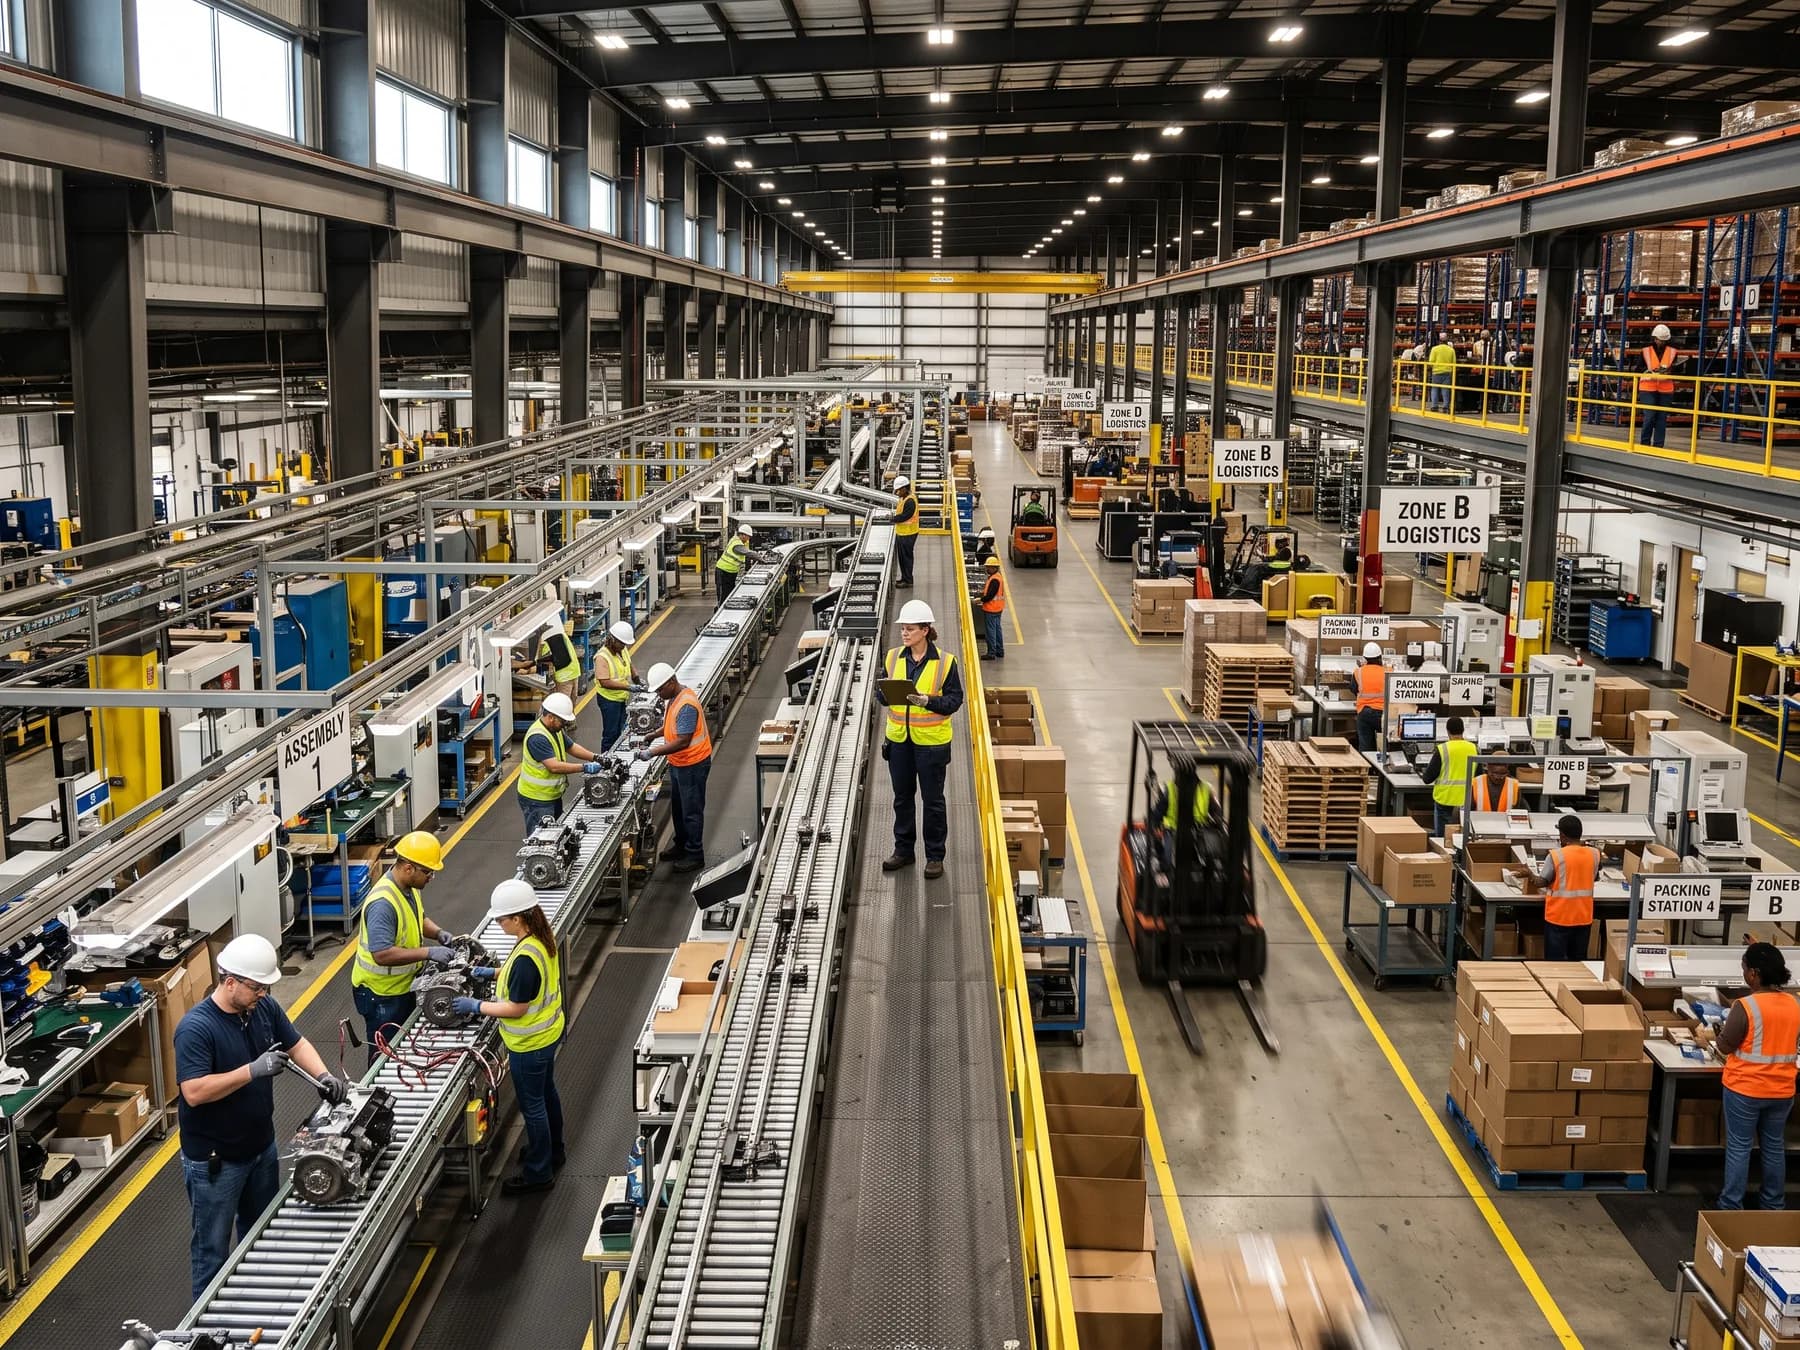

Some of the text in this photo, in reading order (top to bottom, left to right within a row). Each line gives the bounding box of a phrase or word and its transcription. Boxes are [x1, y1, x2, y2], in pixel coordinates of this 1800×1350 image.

[1085, 390, 1091, 399] C
[1110, 406, 1142, 417] ZONE D
[1106, 419, 1146, 428] LOGISTICS
[1224, 445, 1271, 461] ZONE B
[1217, 465, 1279, 477] LOGISTICS
[1398, 495, 1470, 519] ZONE B
[1386, 526, 1481, 543] LOGISTICS
[1322, 627, 1352, 635] STATION
[1372, 626, 1379, 637] B
[1396, 680, 1433, 688] PACKING
[1394, 690, 1435, 699] STATION 4
[1462, 688, 1471, 701] 4
[284, 710, 344, 769] ASSEMBLY
[1547, 761, 1585, 771] ZONE B
[312, 755, 321, 791] 1
[1559, 774, 1571, 790] B
[1654, 884, 1711, 897] PACKING
[1648, 900, 1715, 912] STATION 4
[1768, 895, 1783, 915] B
